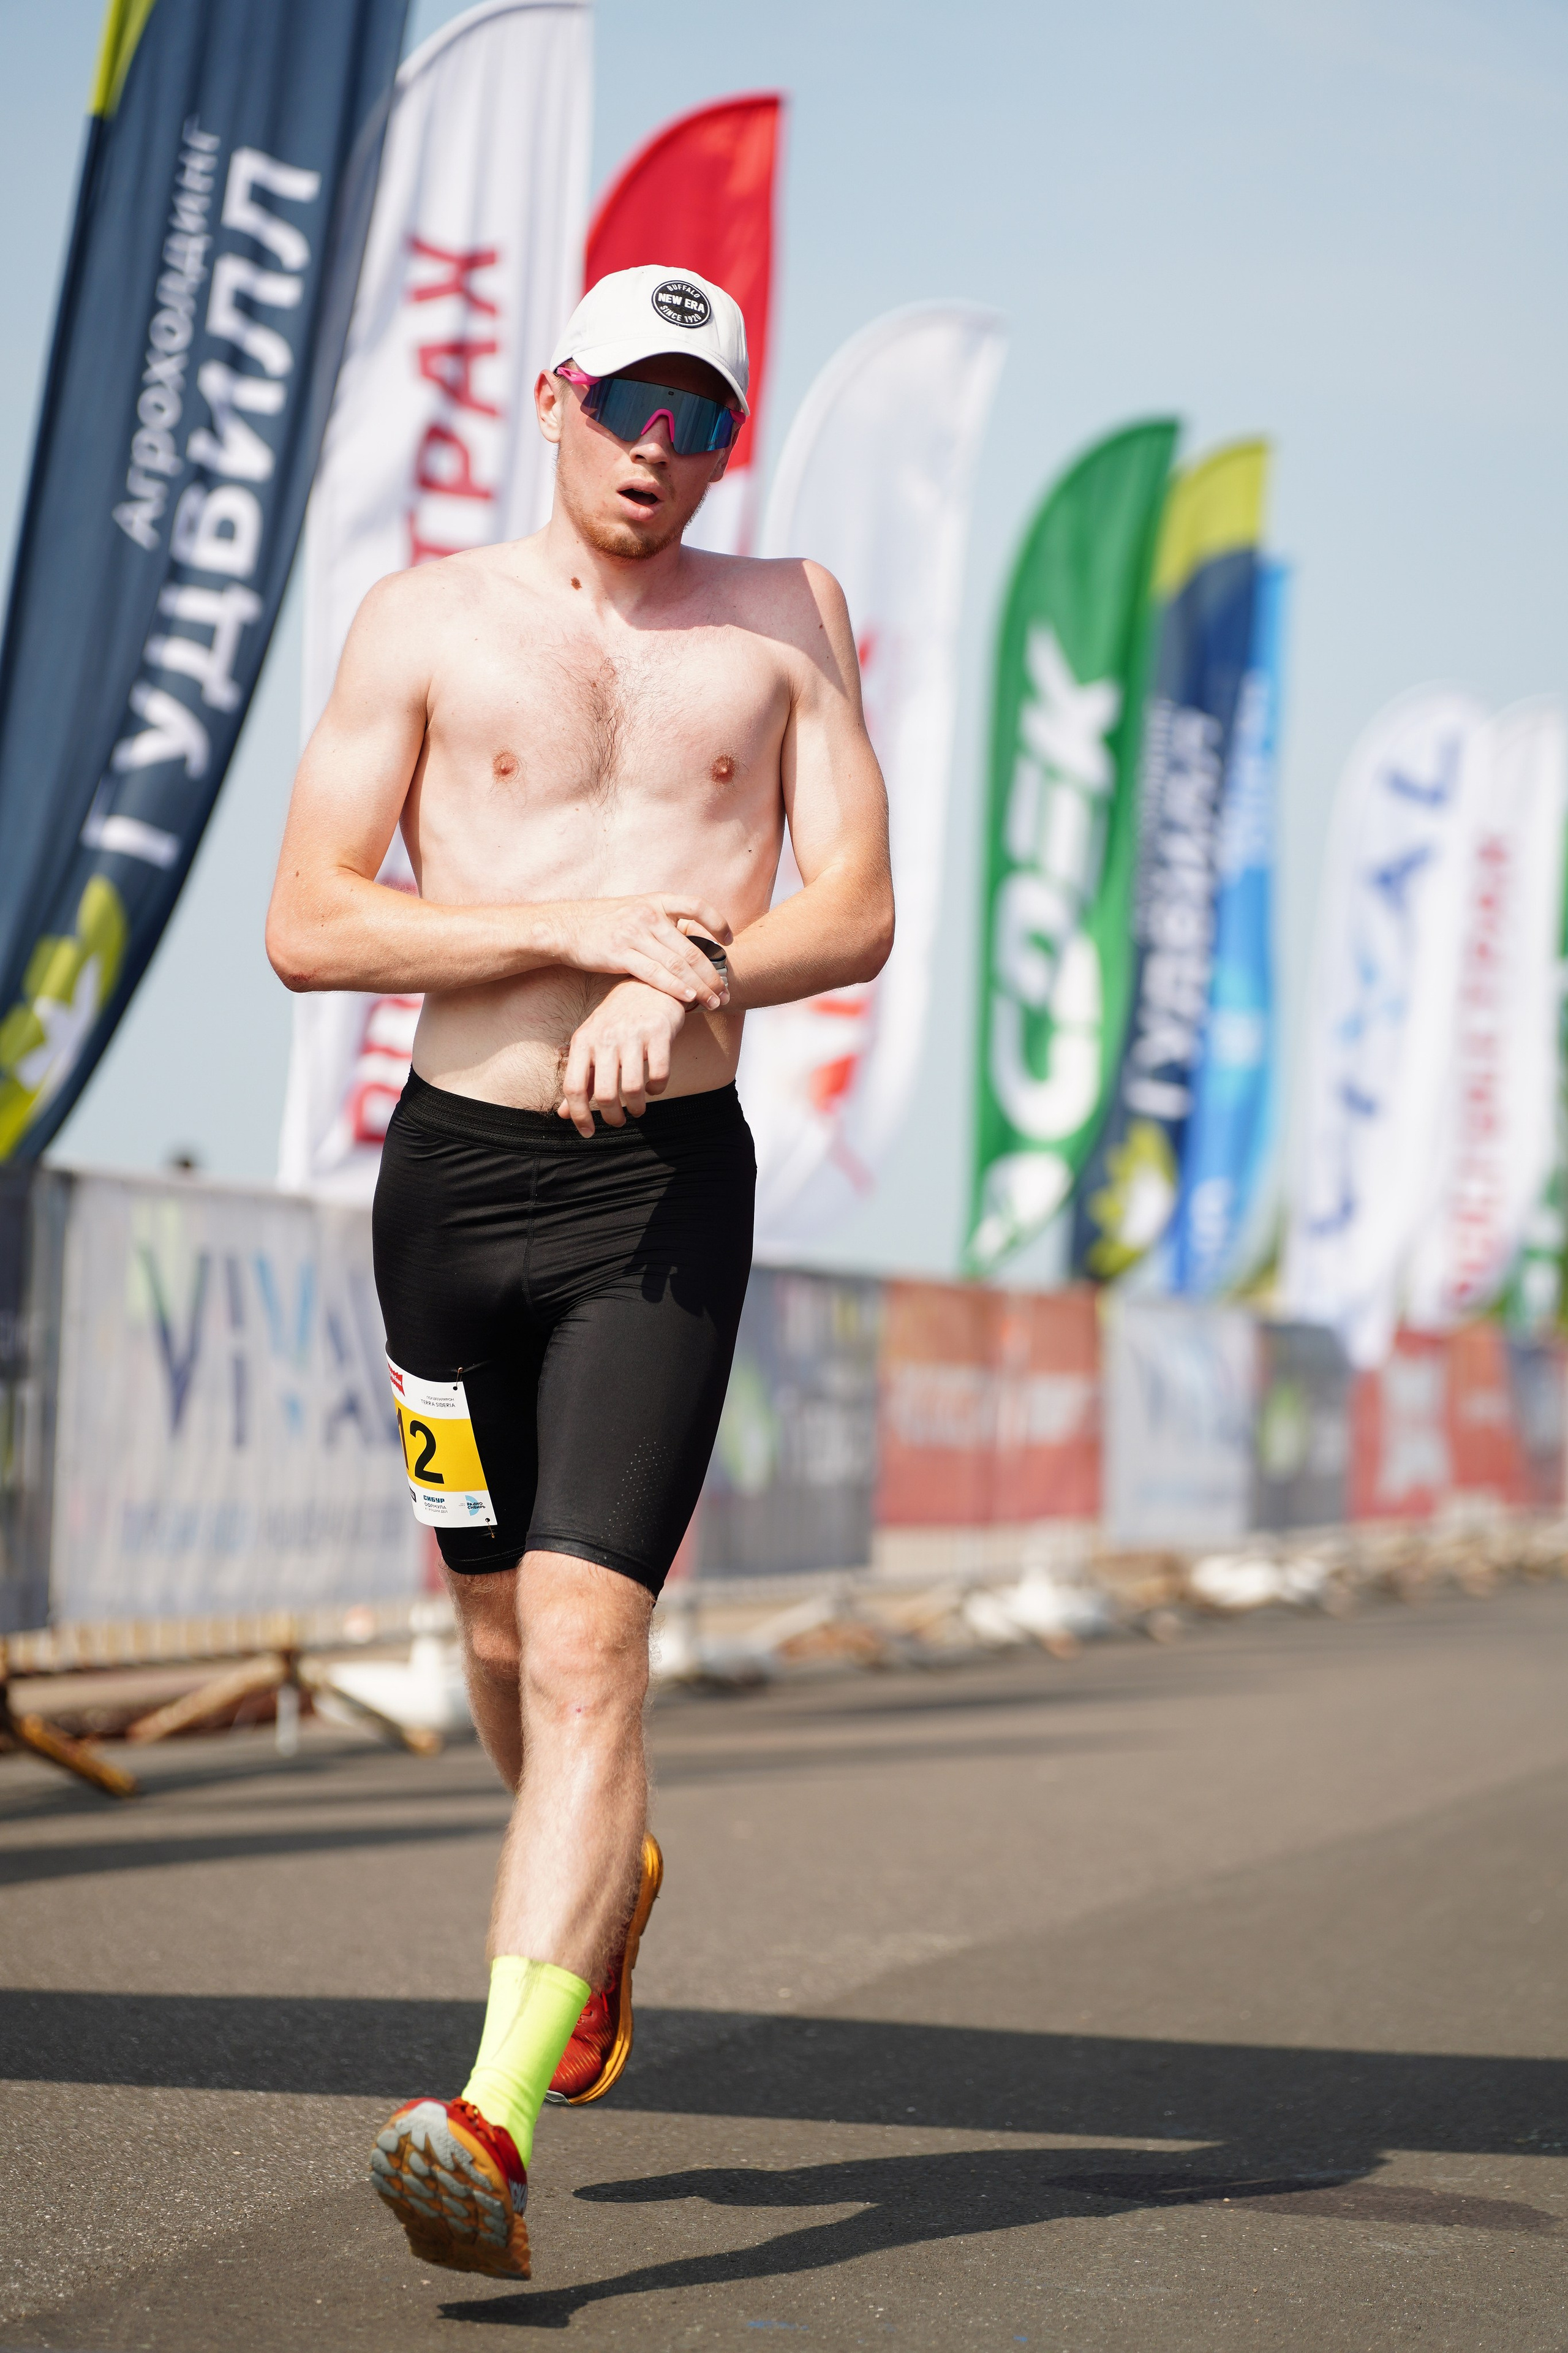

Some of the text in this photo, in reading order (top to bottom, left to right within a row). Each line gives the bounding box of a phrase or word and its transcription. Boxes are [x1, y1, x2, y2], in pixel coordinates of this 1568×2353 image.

[666, 284, 701, 298] BUFFALO
[658, 293, 705, 314] NEW ERA
[660, 305, 702, 323] SINCE 1920
[80, 145, 323, 871] ГУДВИЛЛ
[423, 1495, 445, 1503] СИБУР
